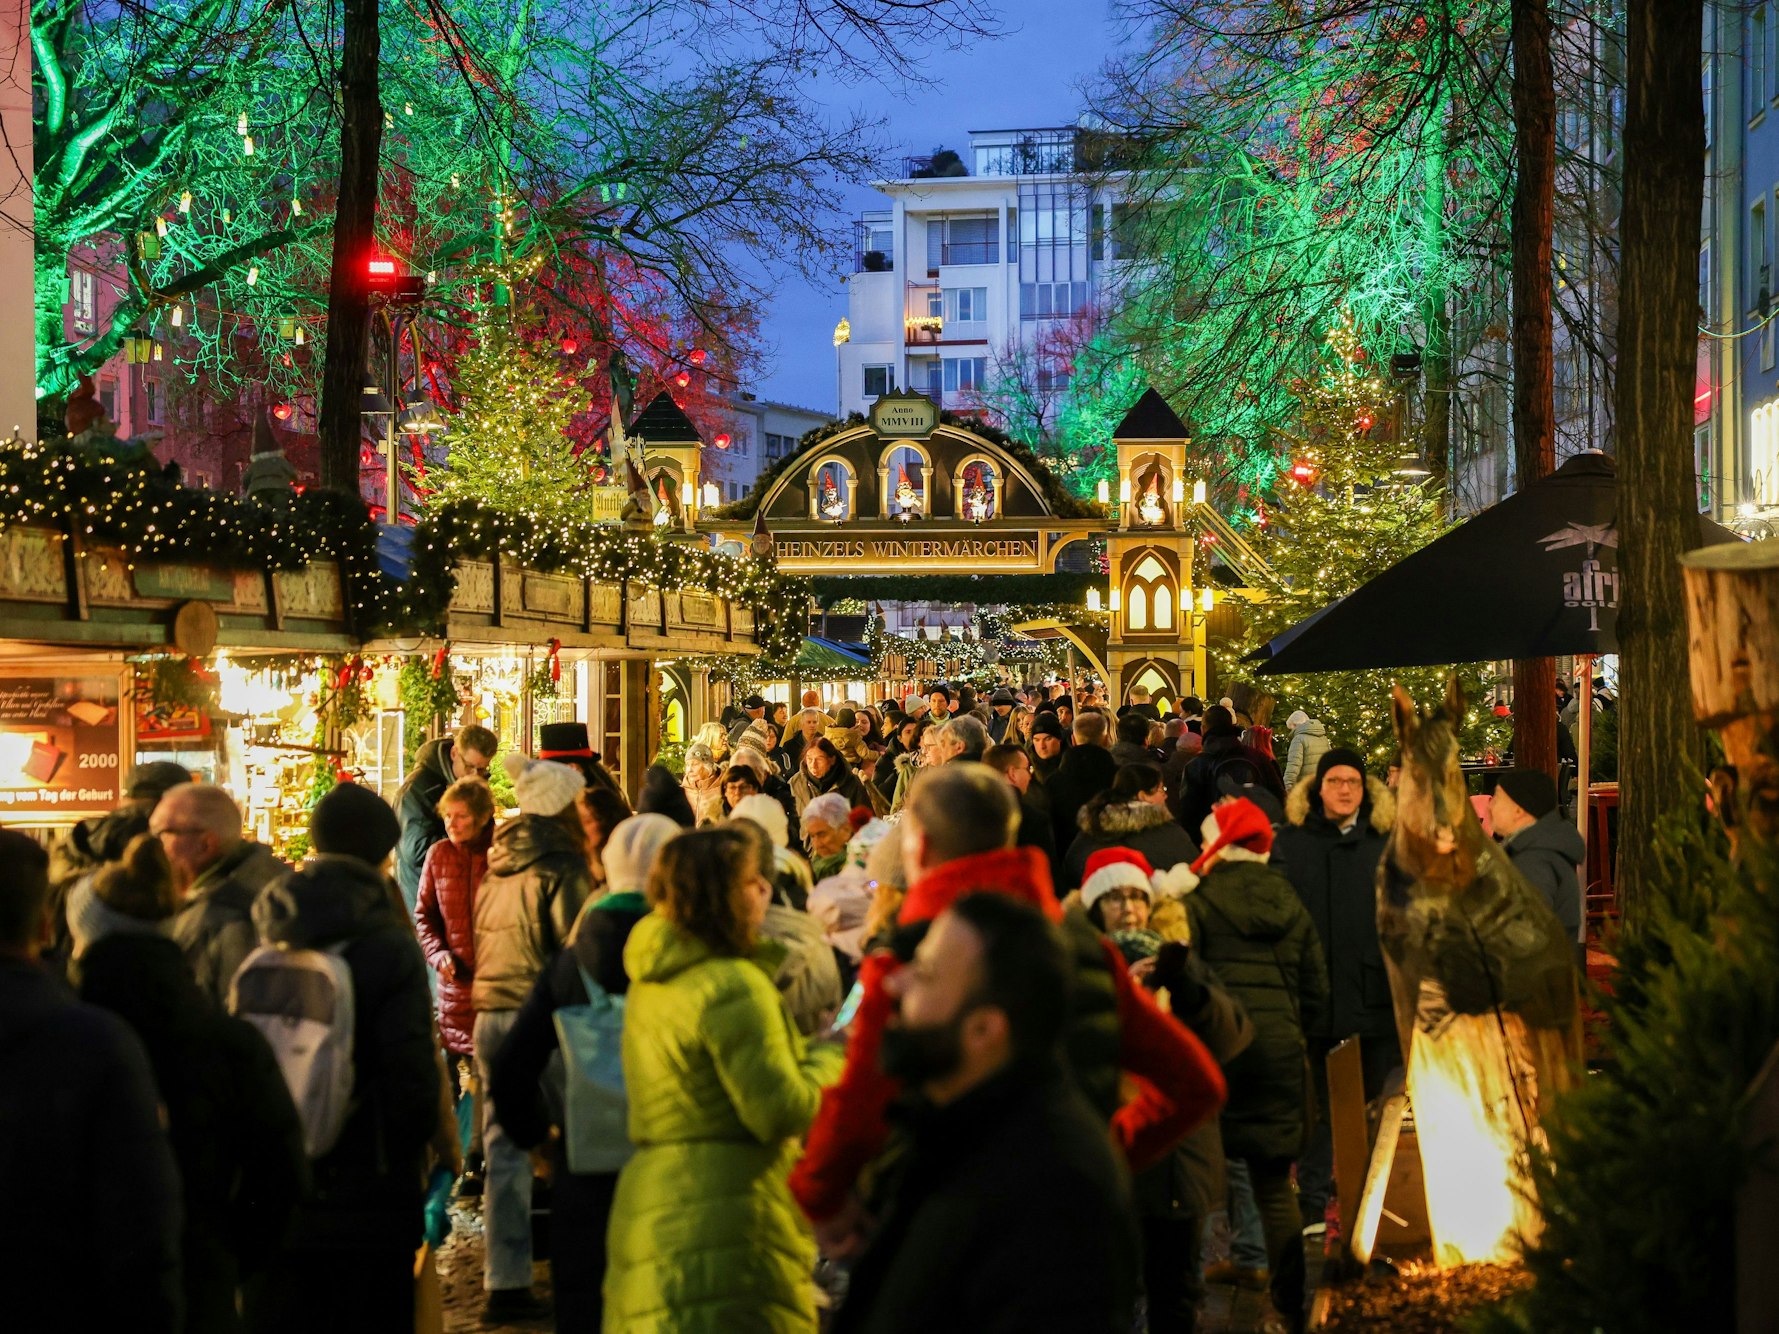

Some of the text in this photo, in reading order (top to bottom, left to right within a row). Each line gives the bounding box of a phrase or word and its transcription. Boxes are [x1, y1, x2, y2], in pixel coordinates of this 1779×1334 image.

[892, 406, 914, 414] Anno
[881, 417, 924, 427] MMVIII
[775, 537, 1038, 558] HEINZELS WINTERMÄRCHEN
[1563, 559, 1619, 602] afri
[79, 753, 118, 768] 2000
[39, 788, 59, 804] Tag
[59, 788, 77, 801] der
[78, 788, 114, 801] Geburt
